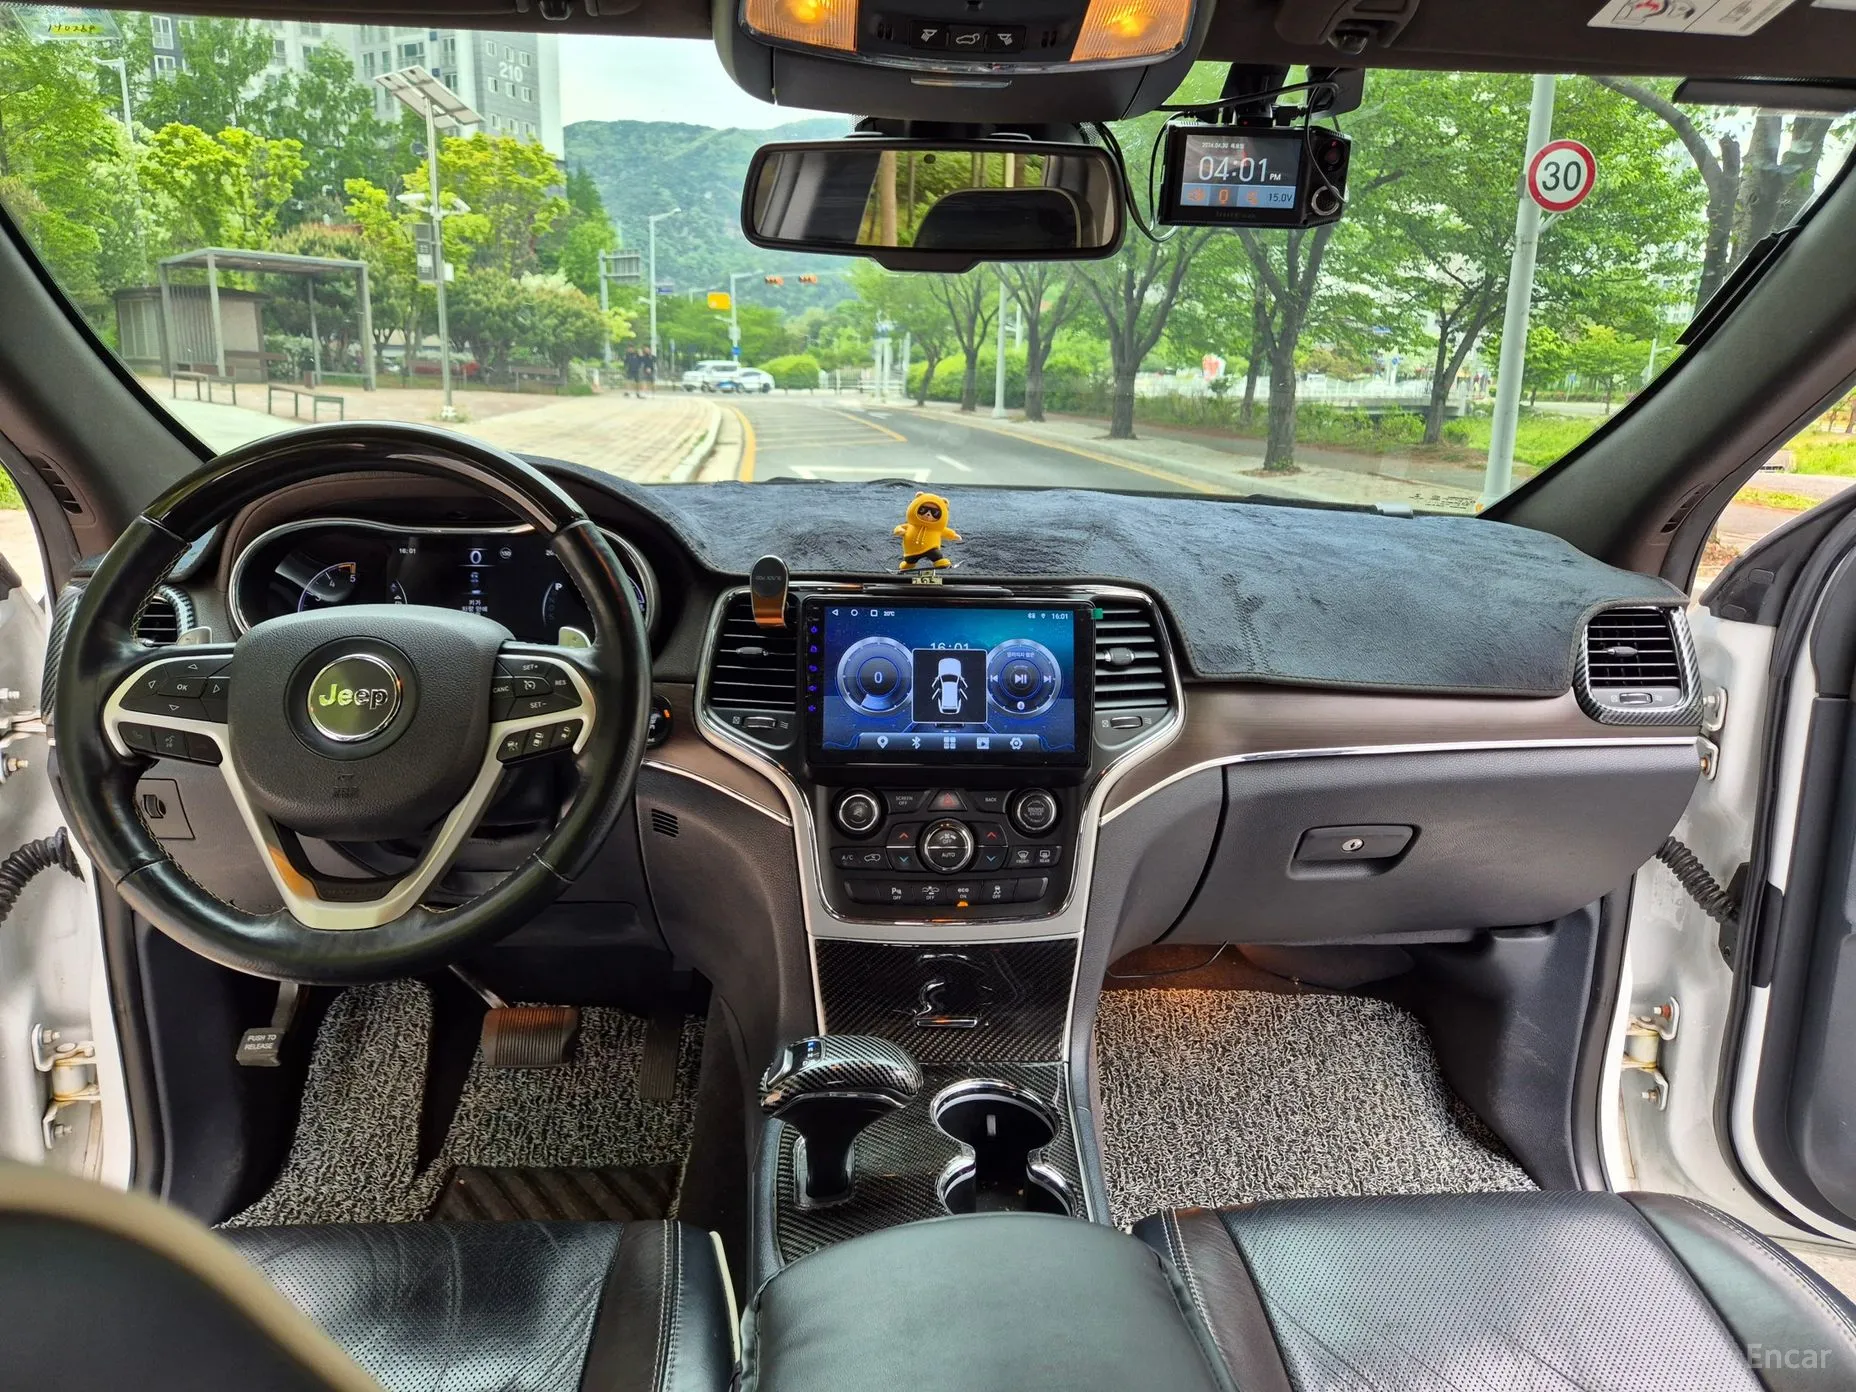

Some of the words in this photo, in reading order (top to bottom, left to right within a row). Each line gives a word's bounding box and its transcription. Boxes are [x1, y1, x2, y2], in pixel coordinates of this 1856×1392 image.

[499, 62, 523, 82] 210
[1199, 156, 1267, 182] 04:01
[1269, 173, 1282, 181] PM
[1542, 161, 1582, 191] 30
[1269, 193, 1293, 202] 15.0V
[350, 575, 356, 583] 5
[555, 583, 563, 591] P
[874, 671, 883, 684] 0
[177, 683, 188, 691] OK
[492, 685, 510, 694] CANC
[319, 684, 389, 710] Jeep
[244, 1042, 274, 1050] RELEASE
